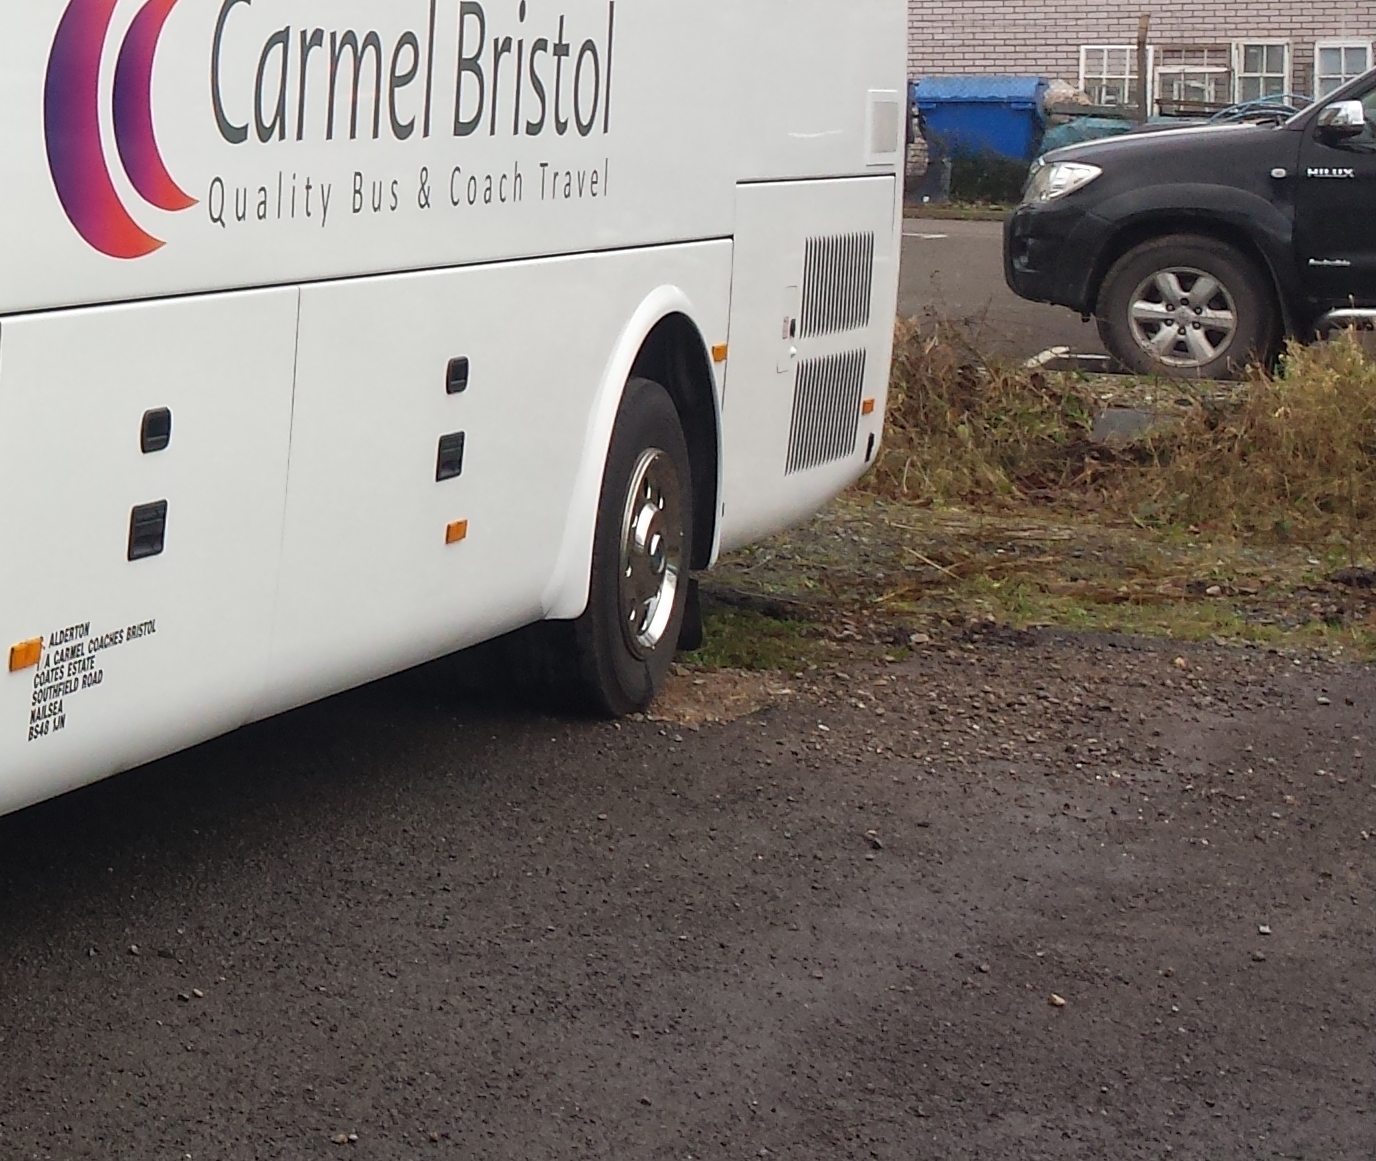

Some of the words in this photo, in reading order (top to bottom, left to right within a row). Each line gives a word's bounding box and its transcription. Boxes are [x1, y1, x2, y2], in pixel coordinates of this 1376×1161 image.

[453, 0, 615, 137] Bristol
[1307, 167, 1354, 178] HILUX
[208, 171, 331, 228] Quality
[352, 171, 399, 214] Bus
[417, 166, 432, 211] &
[451, 161, 523, 207] Coach
[540, 158, 609, 201] Travel
[48, 621, 91, 648] ALDERTON
[53, 642, 85, 666] CARMEL
[88, 628, 125, 654] COACHES
[126, 619, 156, 641] BRISTOL
[31, 677, 79, 706] SOUTHFIELD
[82, 669, 104, 689] ROAD
[33, 664, 65, 689] COATES
[67, 655, 96, 677] ESTATE
[29, 699, 63, 725] NAILSEA
[28, 720, 50, 742] BS48
